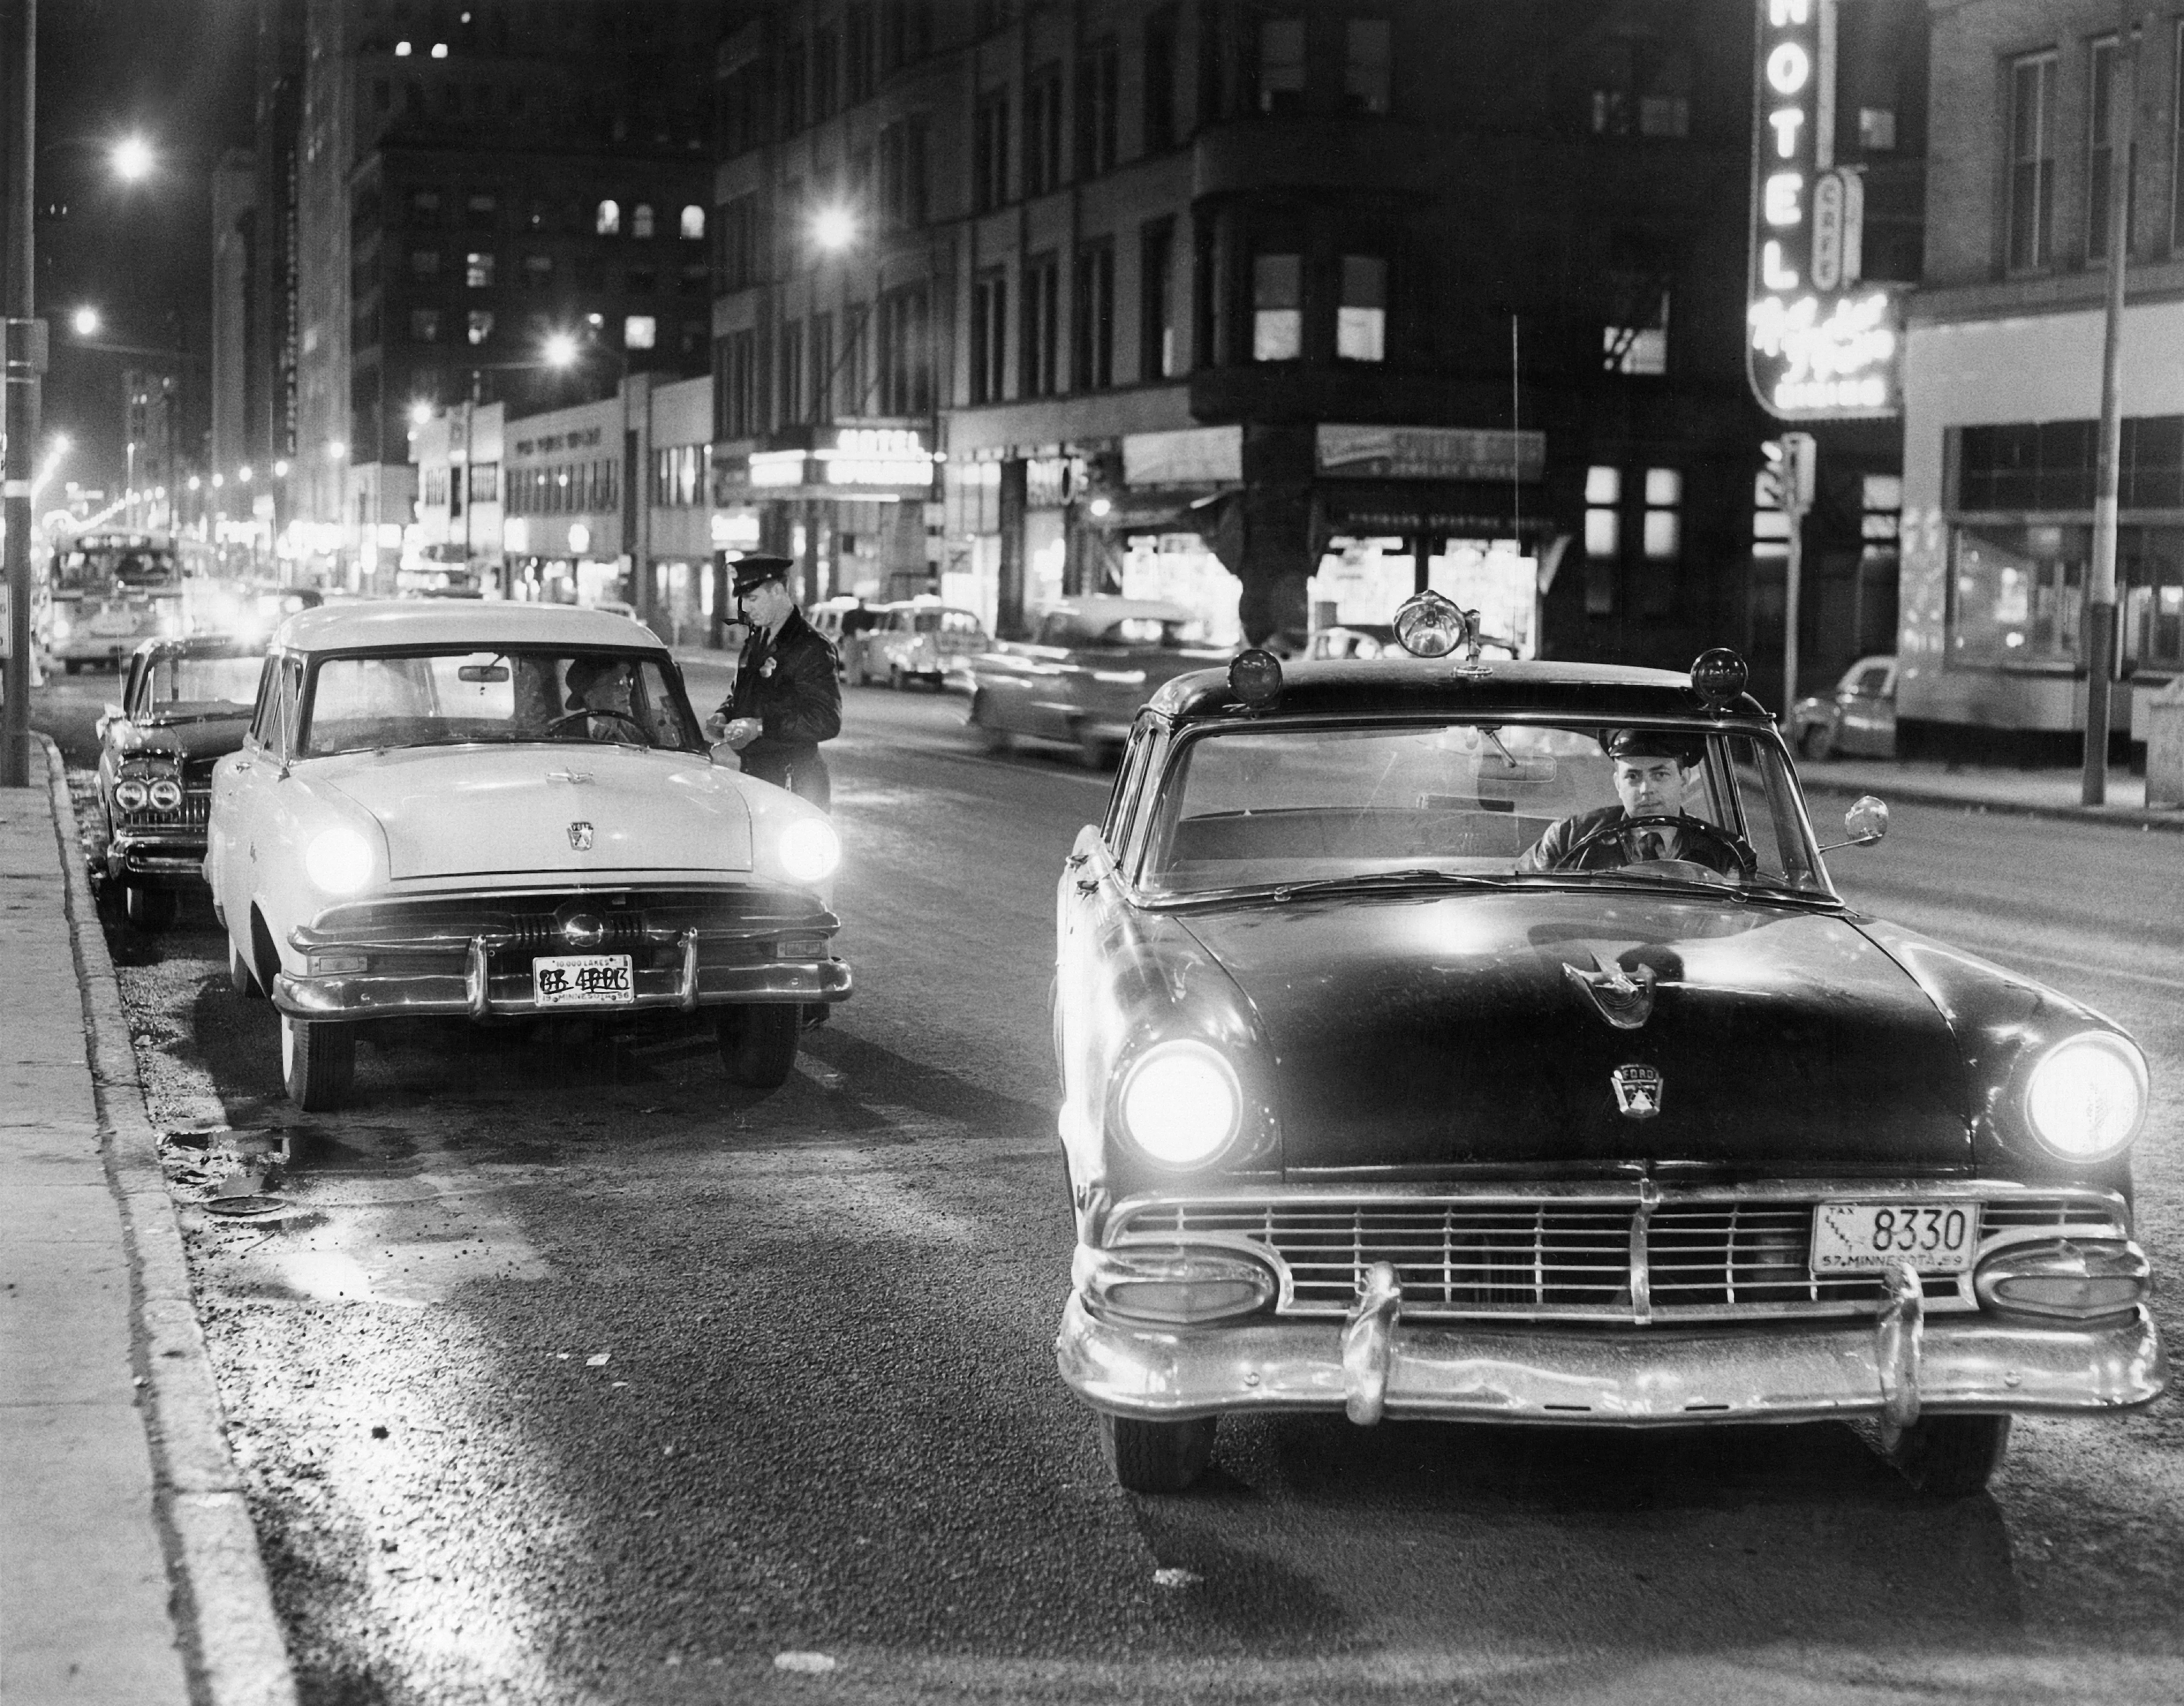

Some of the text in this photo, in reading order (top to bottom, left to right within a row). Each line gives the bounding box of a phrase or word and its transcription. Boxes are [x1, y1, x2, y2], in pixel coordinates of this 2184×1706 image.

[1622, 1068, 1654, 1079] FORD
[1872, 1208, 1966, 1251] 8330
[1847, 1254, 1935, 1267] MINNESOTA
